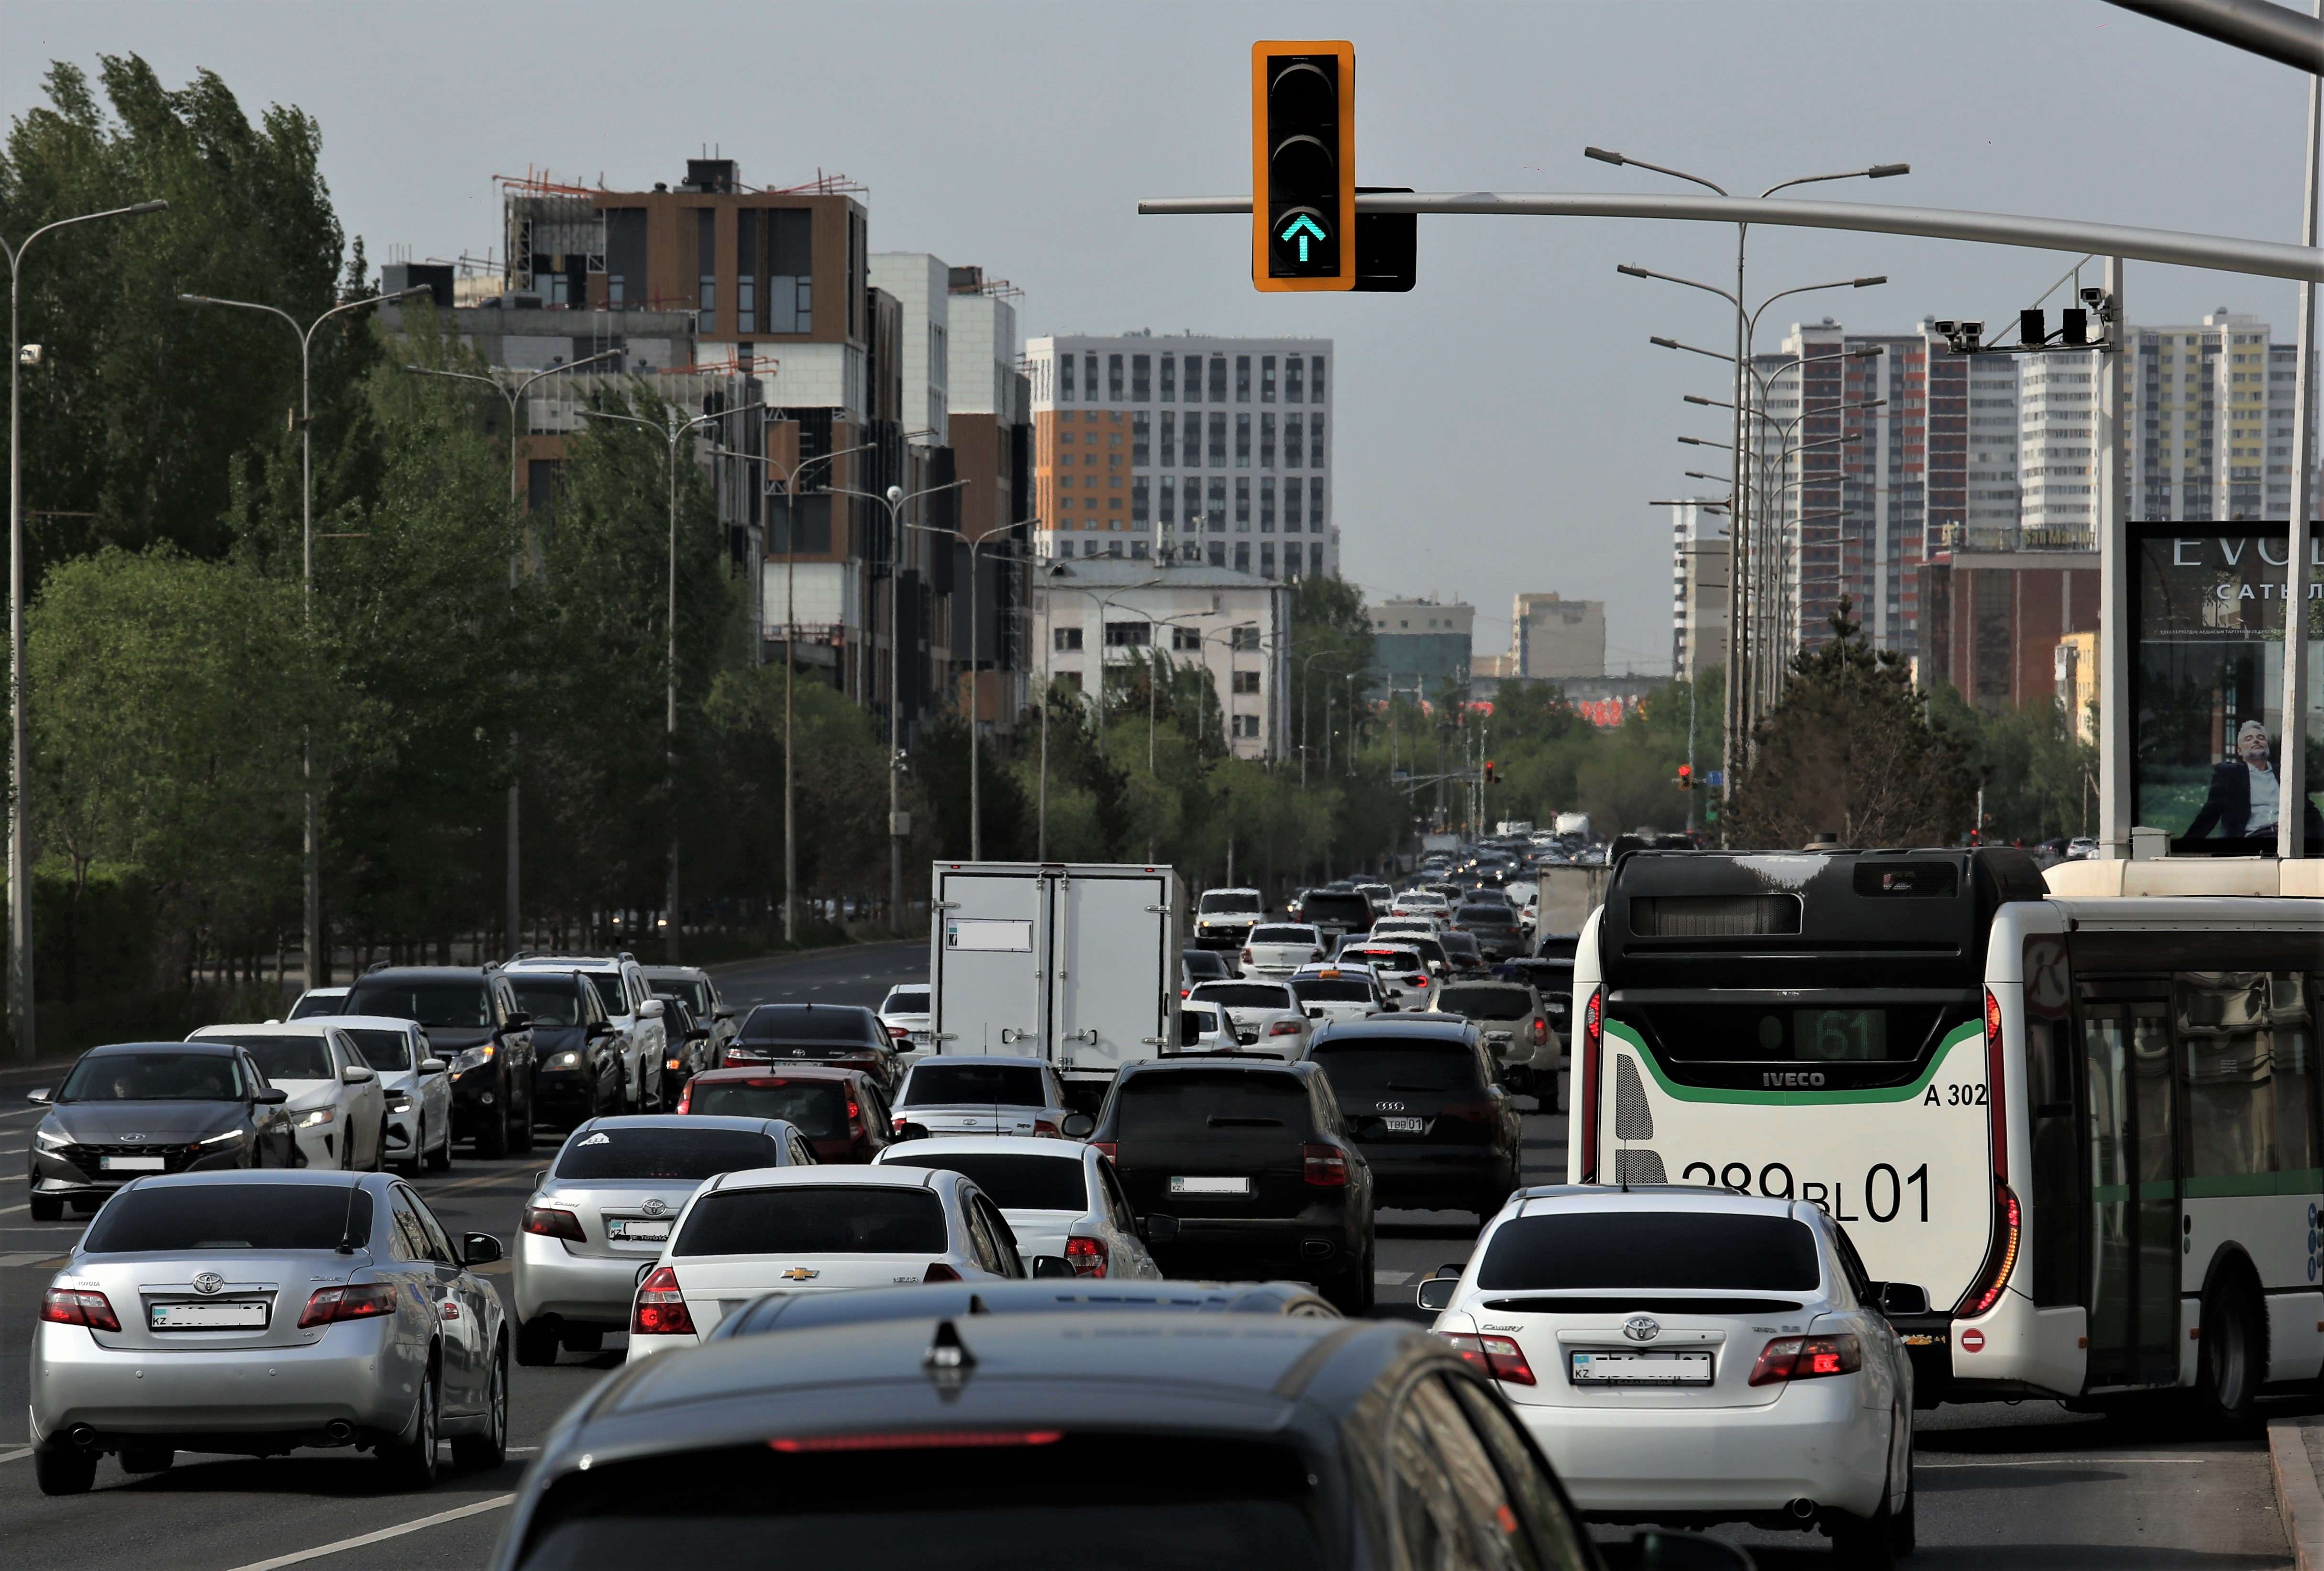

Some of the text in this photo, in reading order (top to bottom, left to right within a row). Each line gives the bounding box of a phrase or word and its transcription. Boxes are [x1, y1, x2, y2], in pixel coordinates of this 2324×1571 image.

[1816, 1010, 1868, 1059] 61
[1763, 1072, 1826, 1087] IVECO
[1924, 1083, 1987, 1107] A 302
[1409, 1119, 1421, 1130] 01
[153, 1317, 166, 1325] KZ
[1575, 1369, 1590, 1378] KZ
